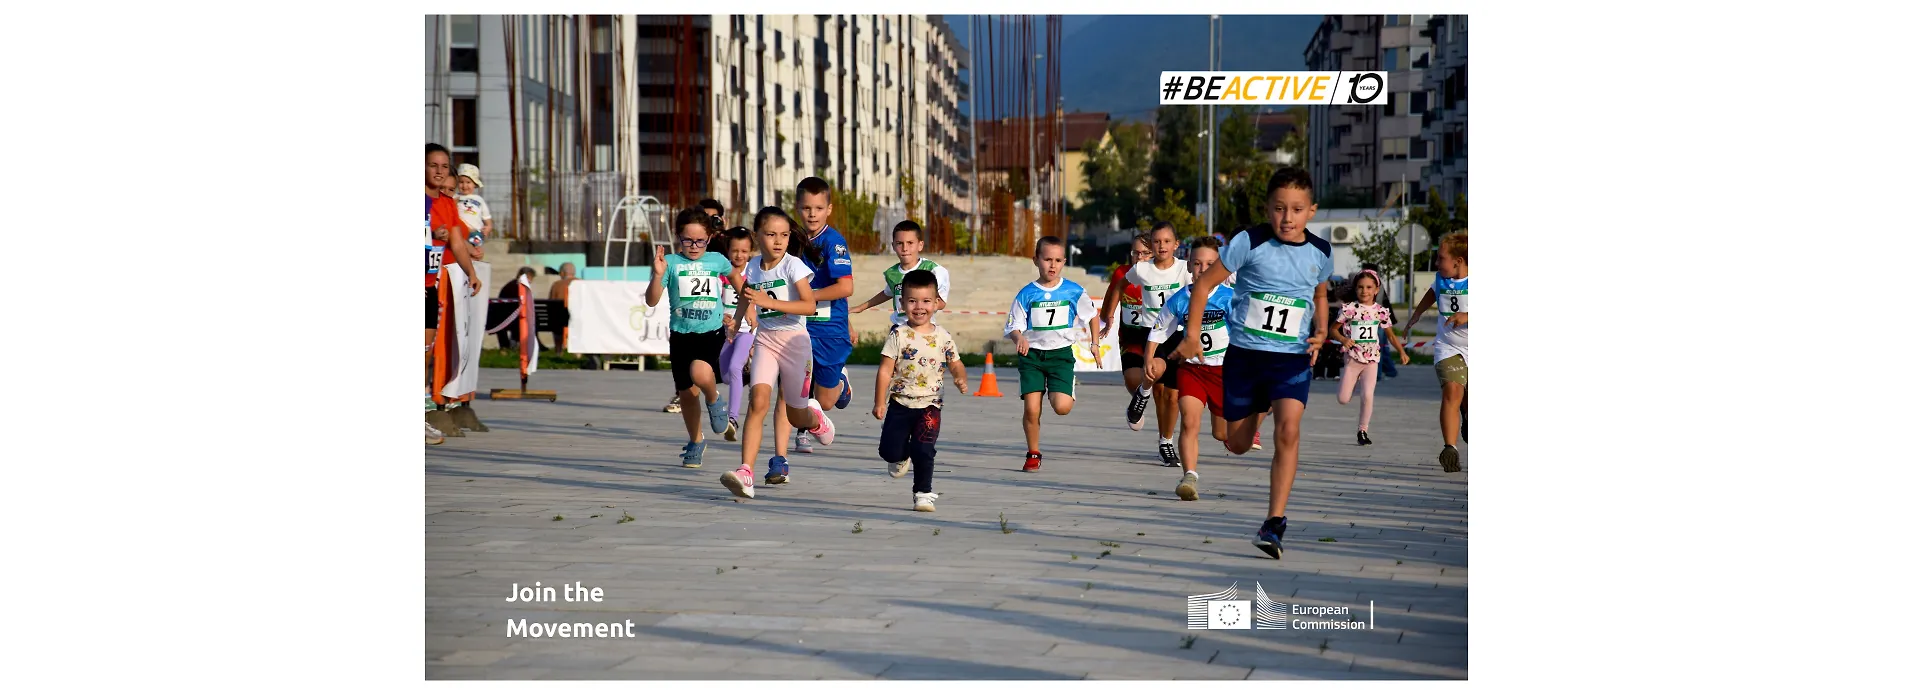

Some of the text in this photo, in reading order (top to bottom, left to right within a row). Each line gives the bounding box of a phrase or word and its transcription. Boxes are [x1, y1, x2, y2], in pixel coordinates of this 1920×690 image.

[430, 253, 442, 269] 15
[690, 277, 711, 296] 24
[1263, 293, 1296, 306] ATLETIST
[1450, 296, 1460, 312] 8
[1045, 308, 1056, 326] 7
[1130, 310, 1140, 325] 2
[1262, 305, 1289, 333] 11
[1359, 326, 1373, 340] 21
[1200, 332, 1213, 351] 9
